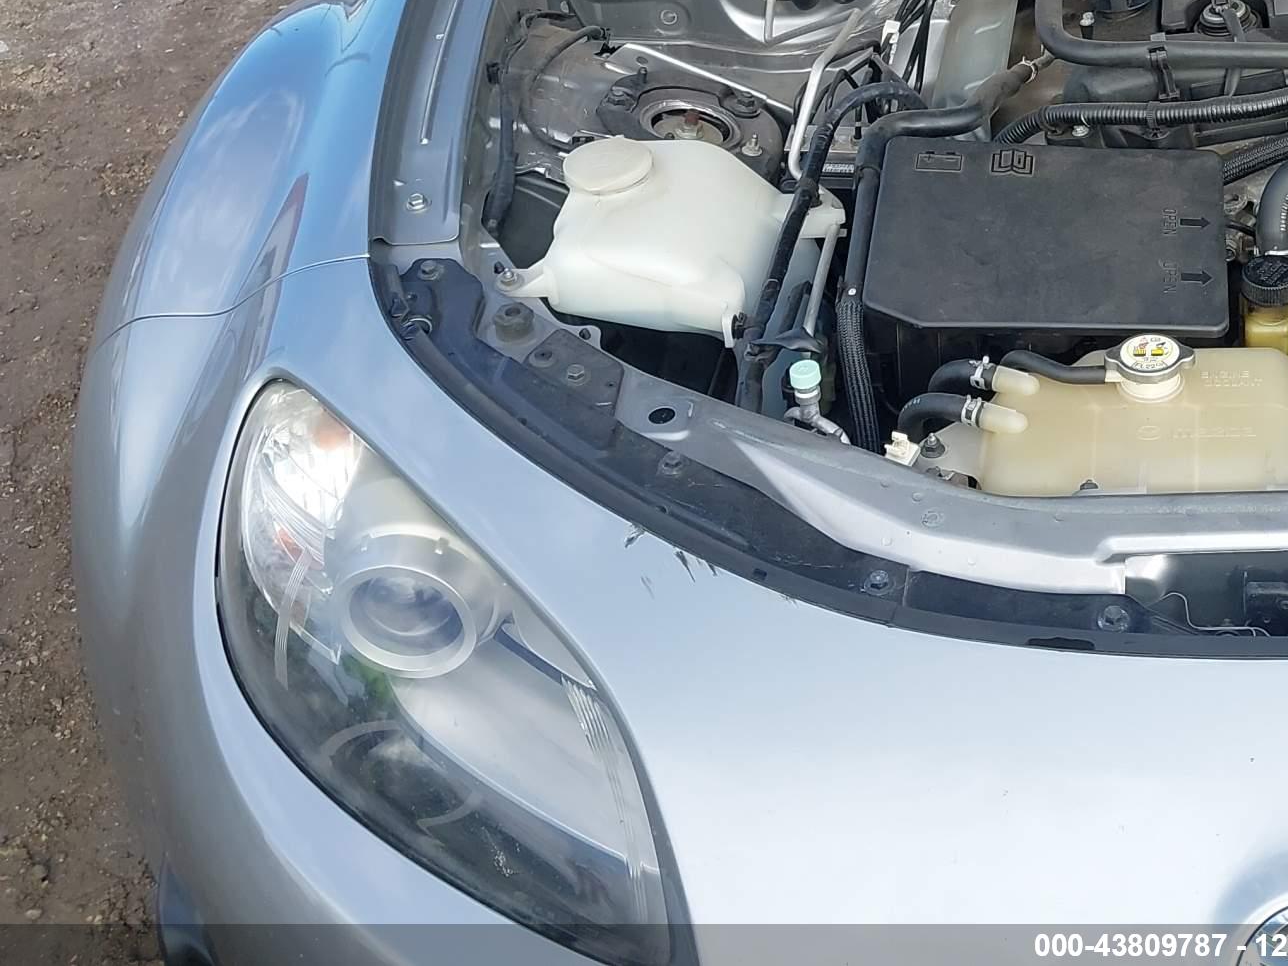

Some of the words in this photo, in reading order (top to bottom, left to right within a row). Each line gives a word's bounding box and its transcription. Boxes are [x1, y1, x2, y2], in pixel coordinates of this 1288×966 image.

[1162, 208, 1177, 235] OPEN
[1201, 370, 1250, 379] ENGINE
[1204, 378, 1263, 388] COOLANT
